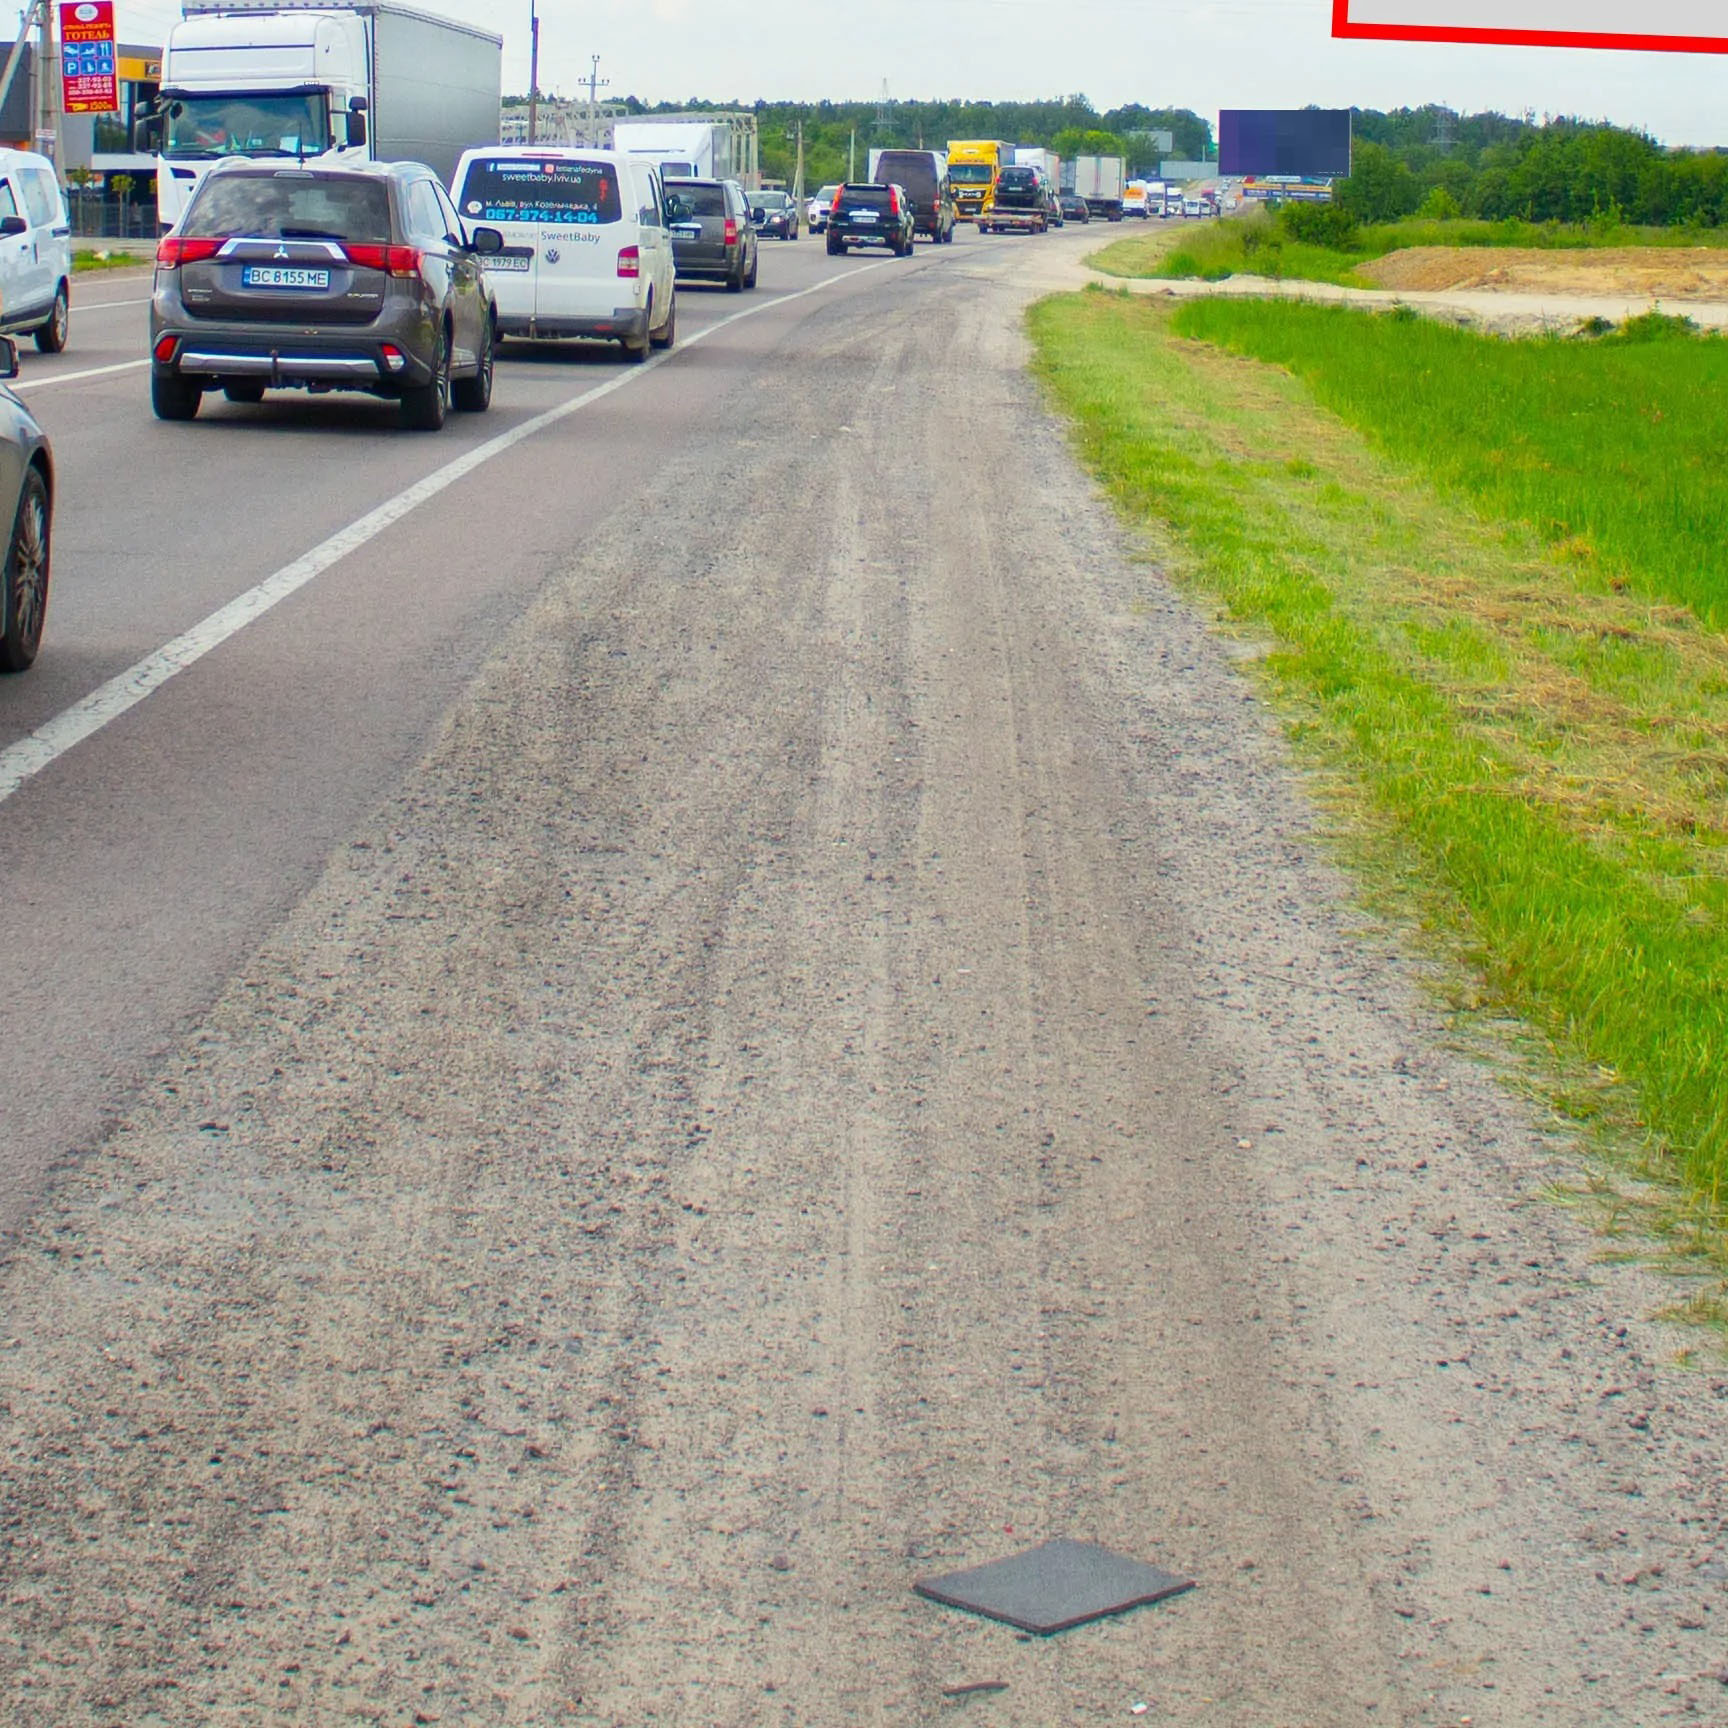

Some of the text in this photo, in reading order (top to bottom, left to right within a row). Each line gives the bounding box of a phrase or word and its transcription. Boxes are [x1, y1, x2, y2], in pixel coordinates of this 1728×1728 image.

[65, 30, 110, 41] ГОТЕЛЬ
[502, 172, 581, 184] sweetbaby.lviv.ua
[485, 208, 598, 223] 067-974-14-04
[541, 230, 601, 243] SweetBaby
[251, 269, 327, 286] BC 8155 ME
